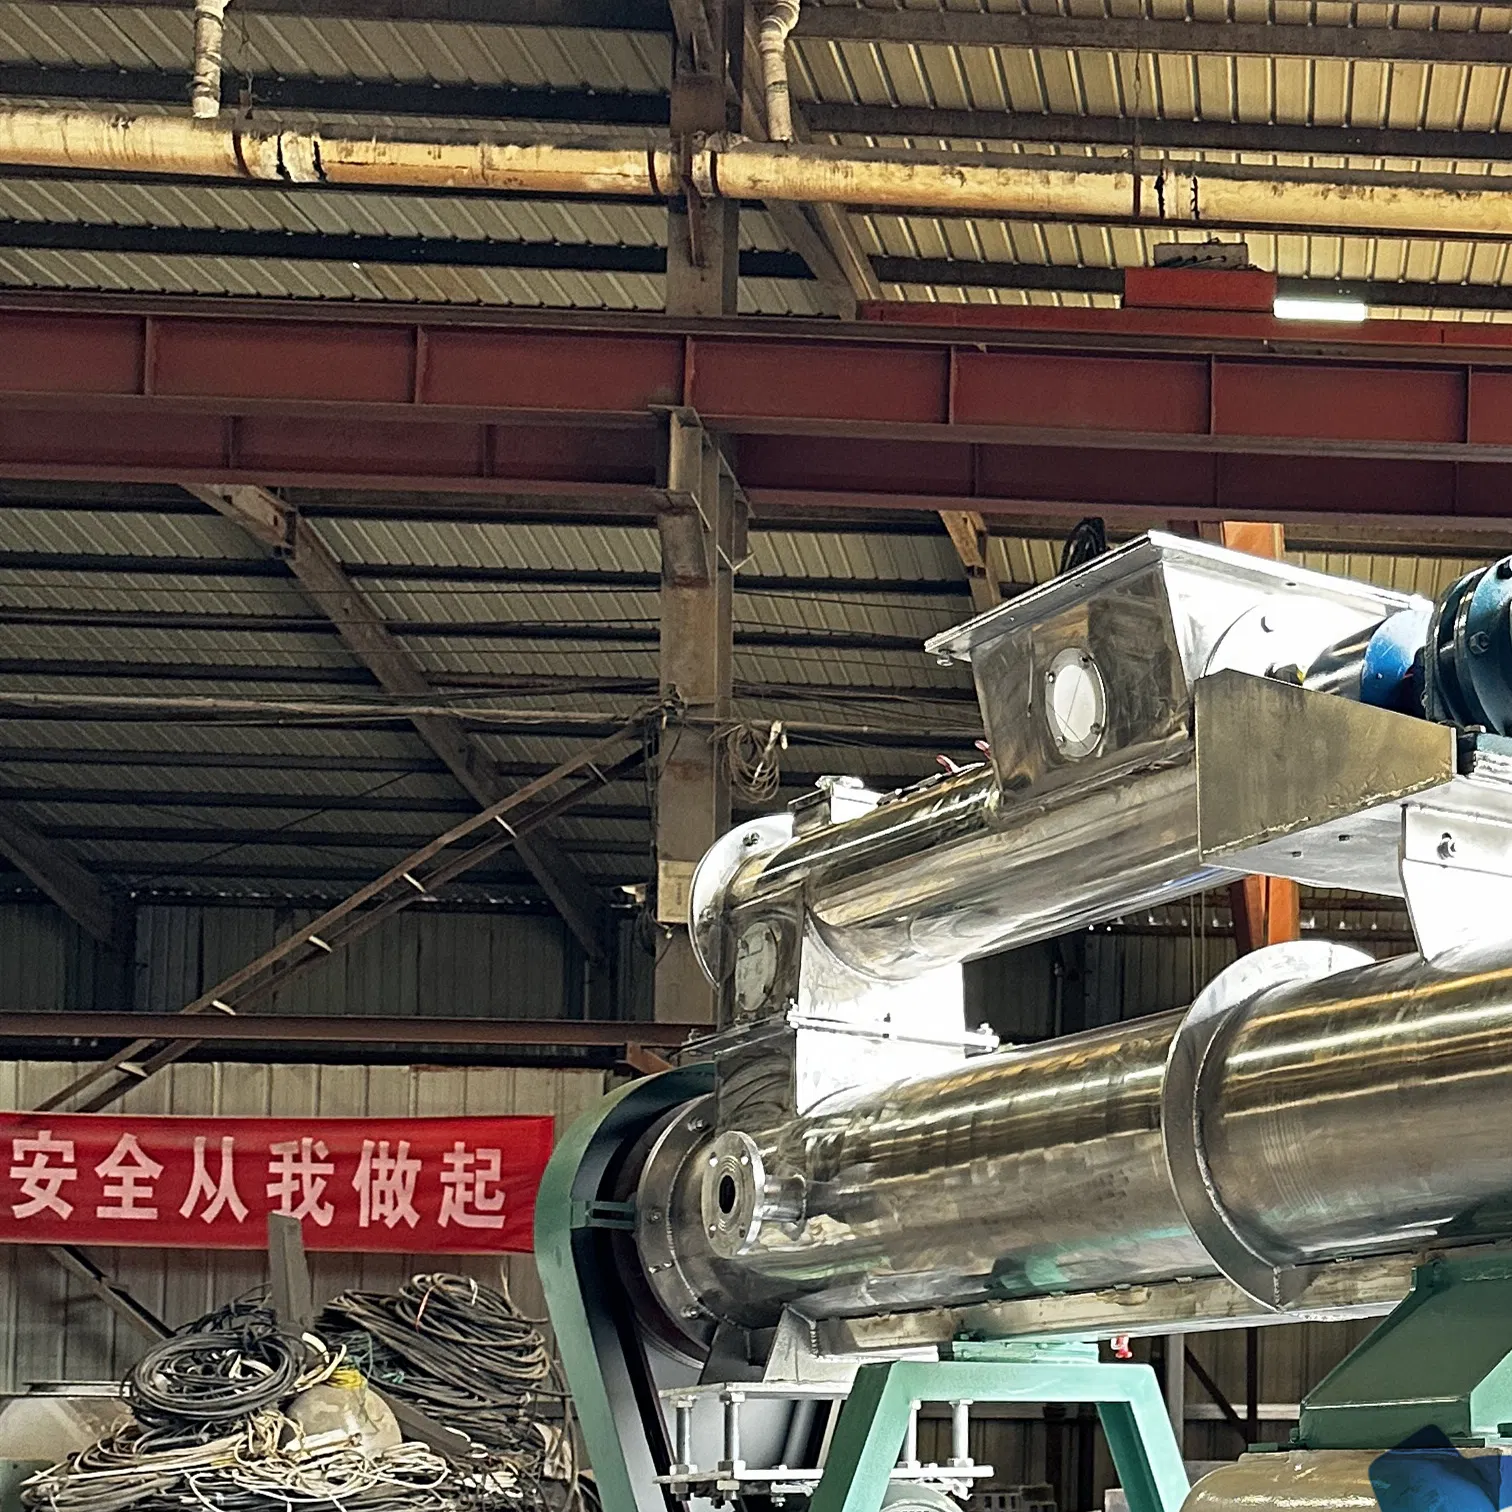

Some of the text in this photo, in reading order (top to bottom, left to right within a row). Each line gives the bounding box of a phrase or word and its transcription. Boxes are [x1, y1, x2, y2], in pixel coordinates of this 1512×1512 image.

[9, 1130, 506, 1229] 安全从我做起
